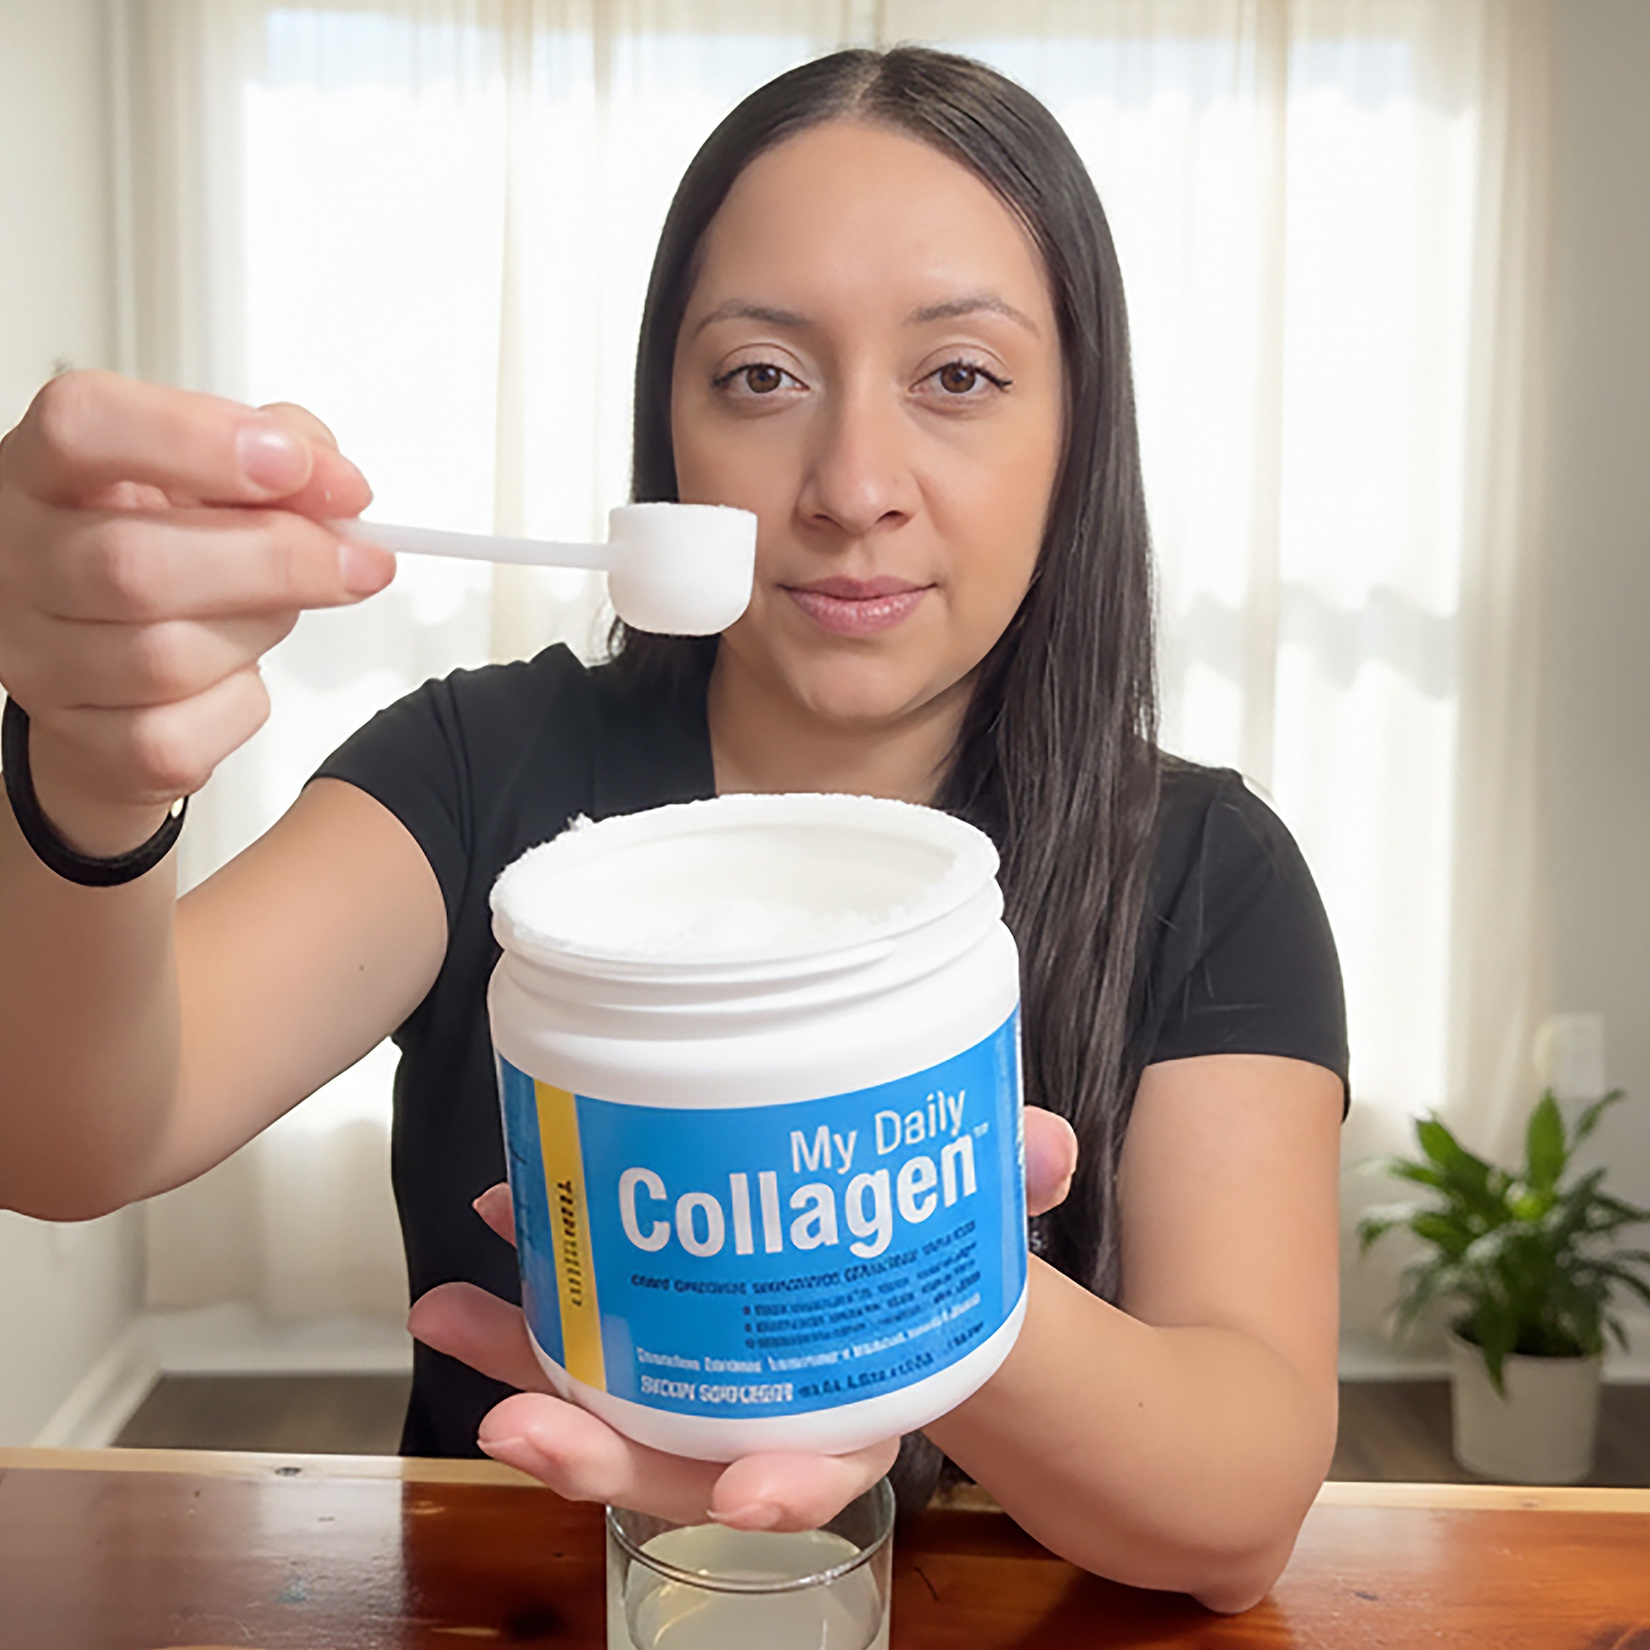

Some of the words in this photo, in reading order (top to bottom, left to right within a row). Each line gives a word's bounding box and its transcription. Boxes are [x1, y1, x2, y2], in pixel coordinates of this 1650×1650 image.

[790, 1125, 857, 1174] My
[874, 1090, 965, 1155] Daily
[618, 1134, 977, 1258] Collagen
